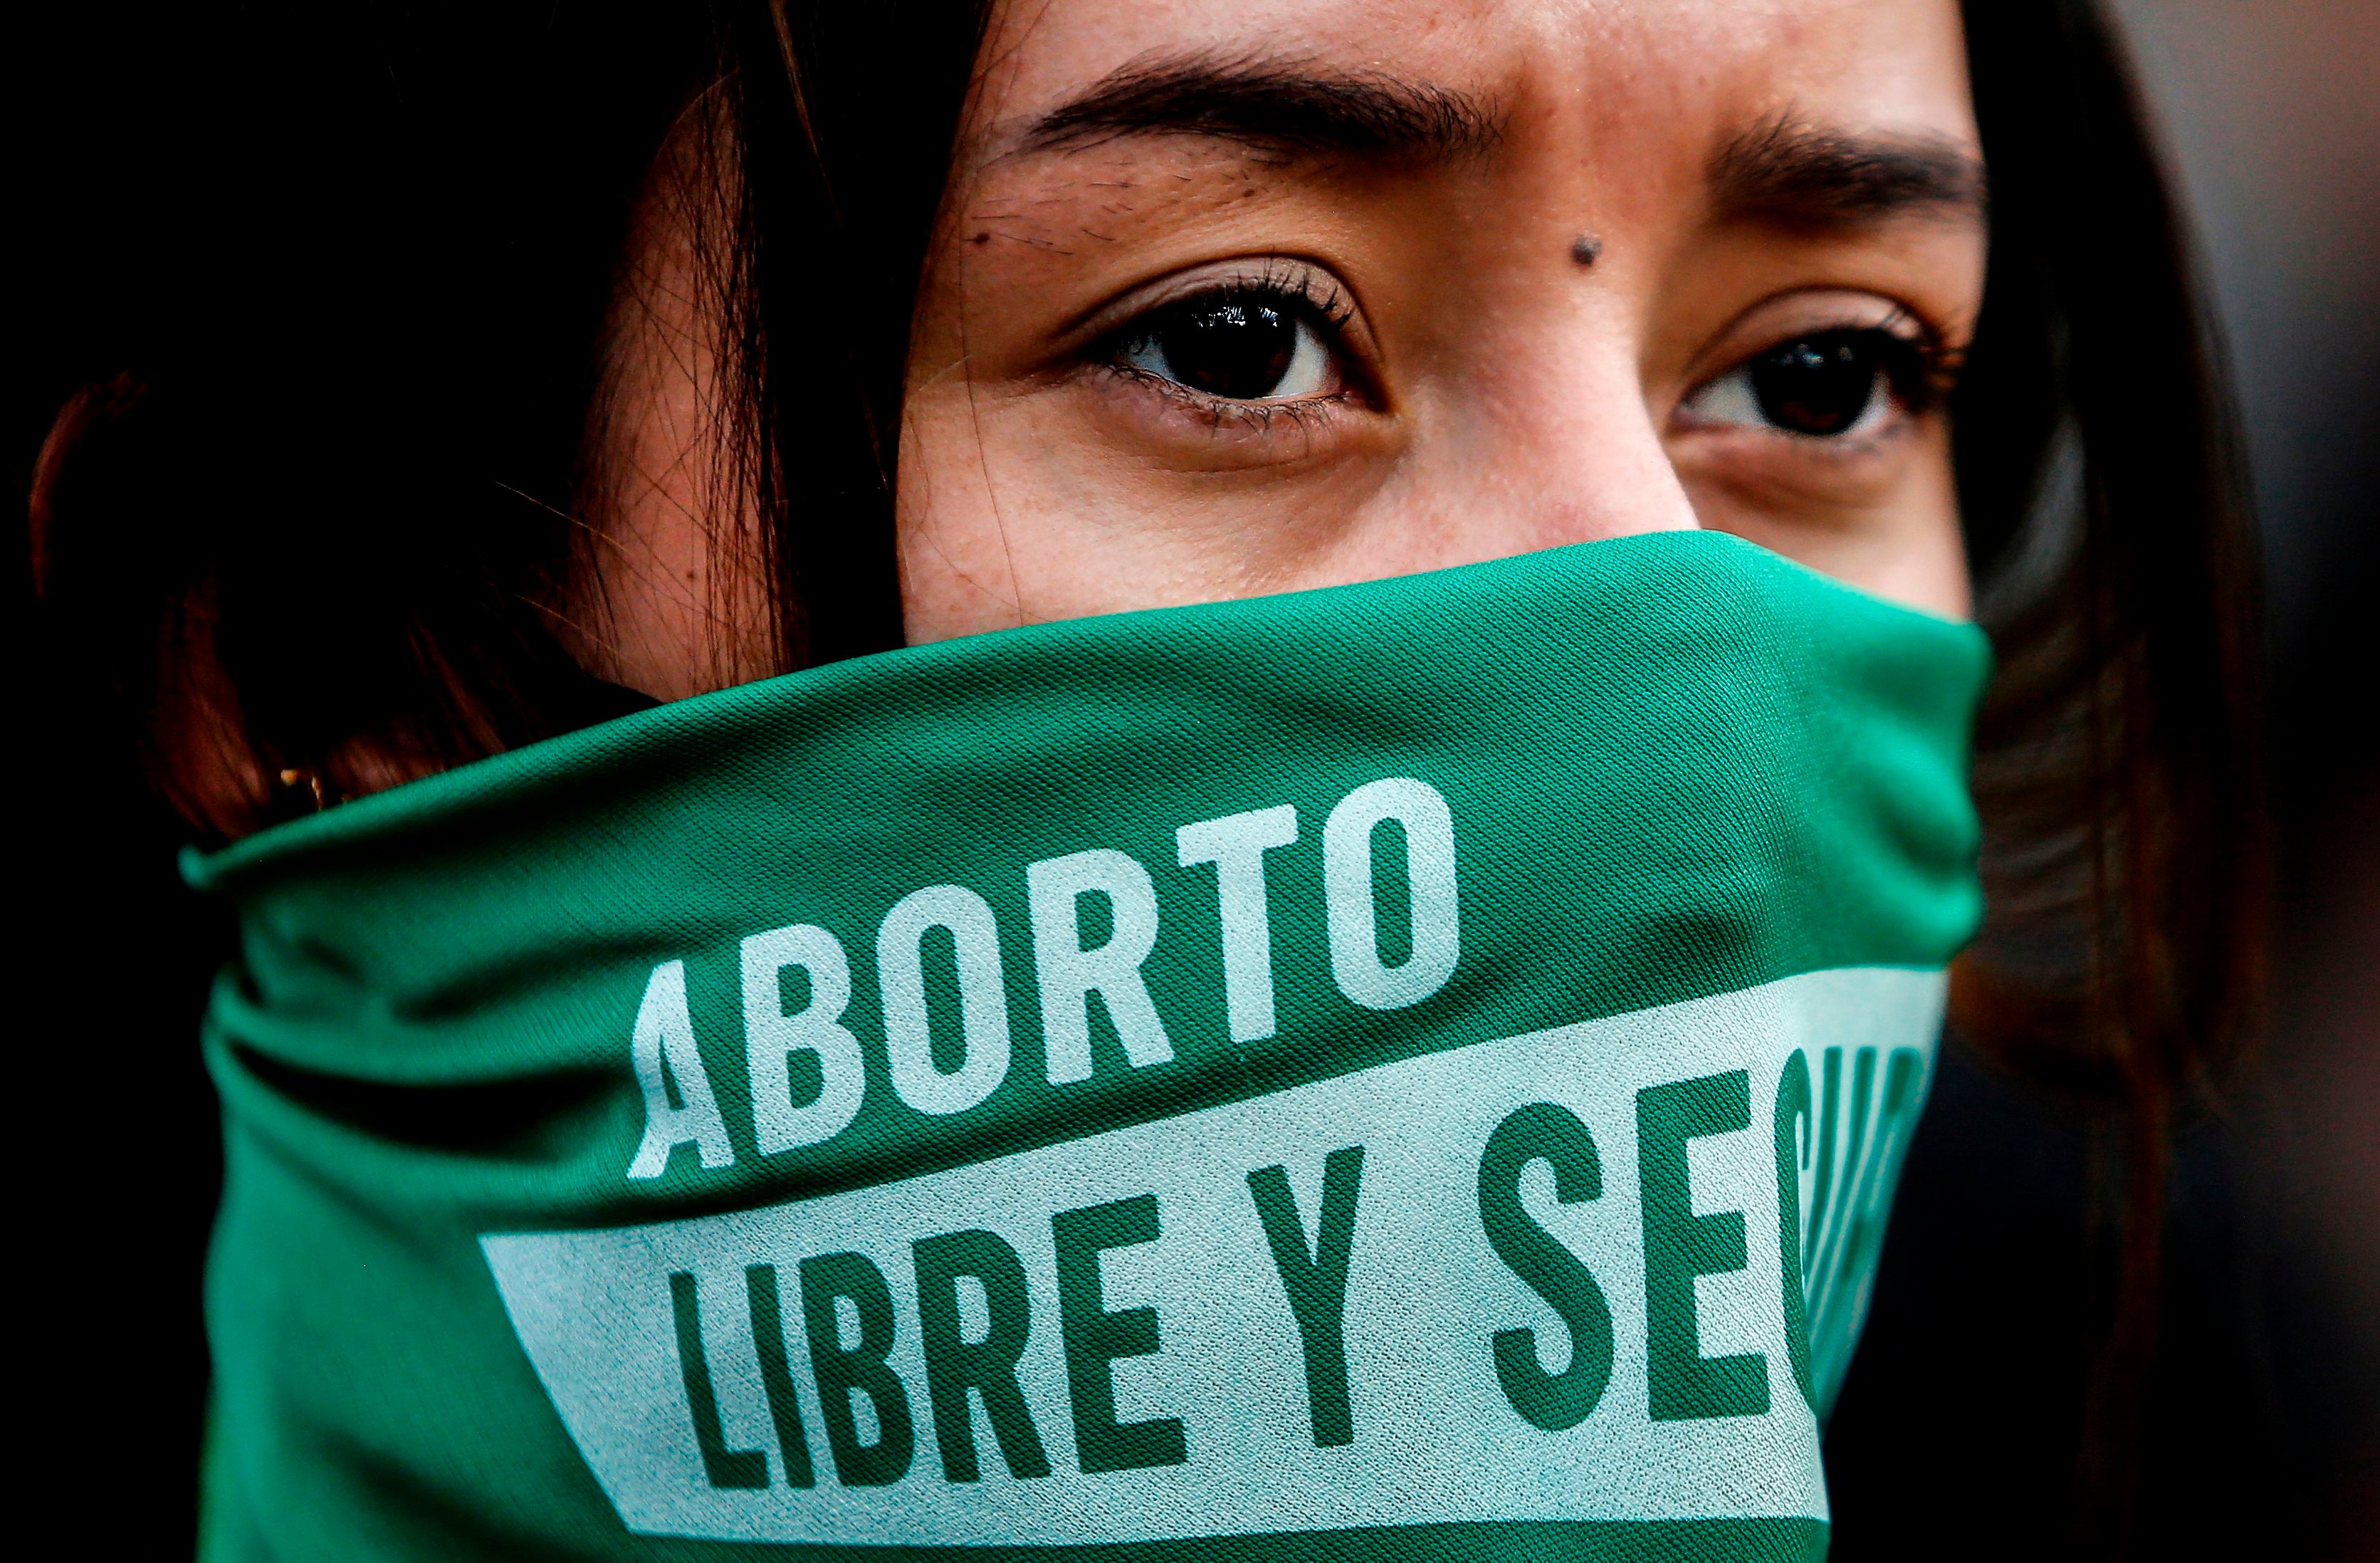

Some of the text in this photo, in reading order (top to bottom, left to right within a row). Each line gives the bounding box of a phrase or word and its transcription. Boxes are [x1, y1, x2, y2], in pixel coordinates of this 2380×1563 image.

[627, 777, 1460, 1179] ABORTO
[670, 1193, 1188, 1490] LIBRE
[1247, 1145, 1365, 1448] Y
